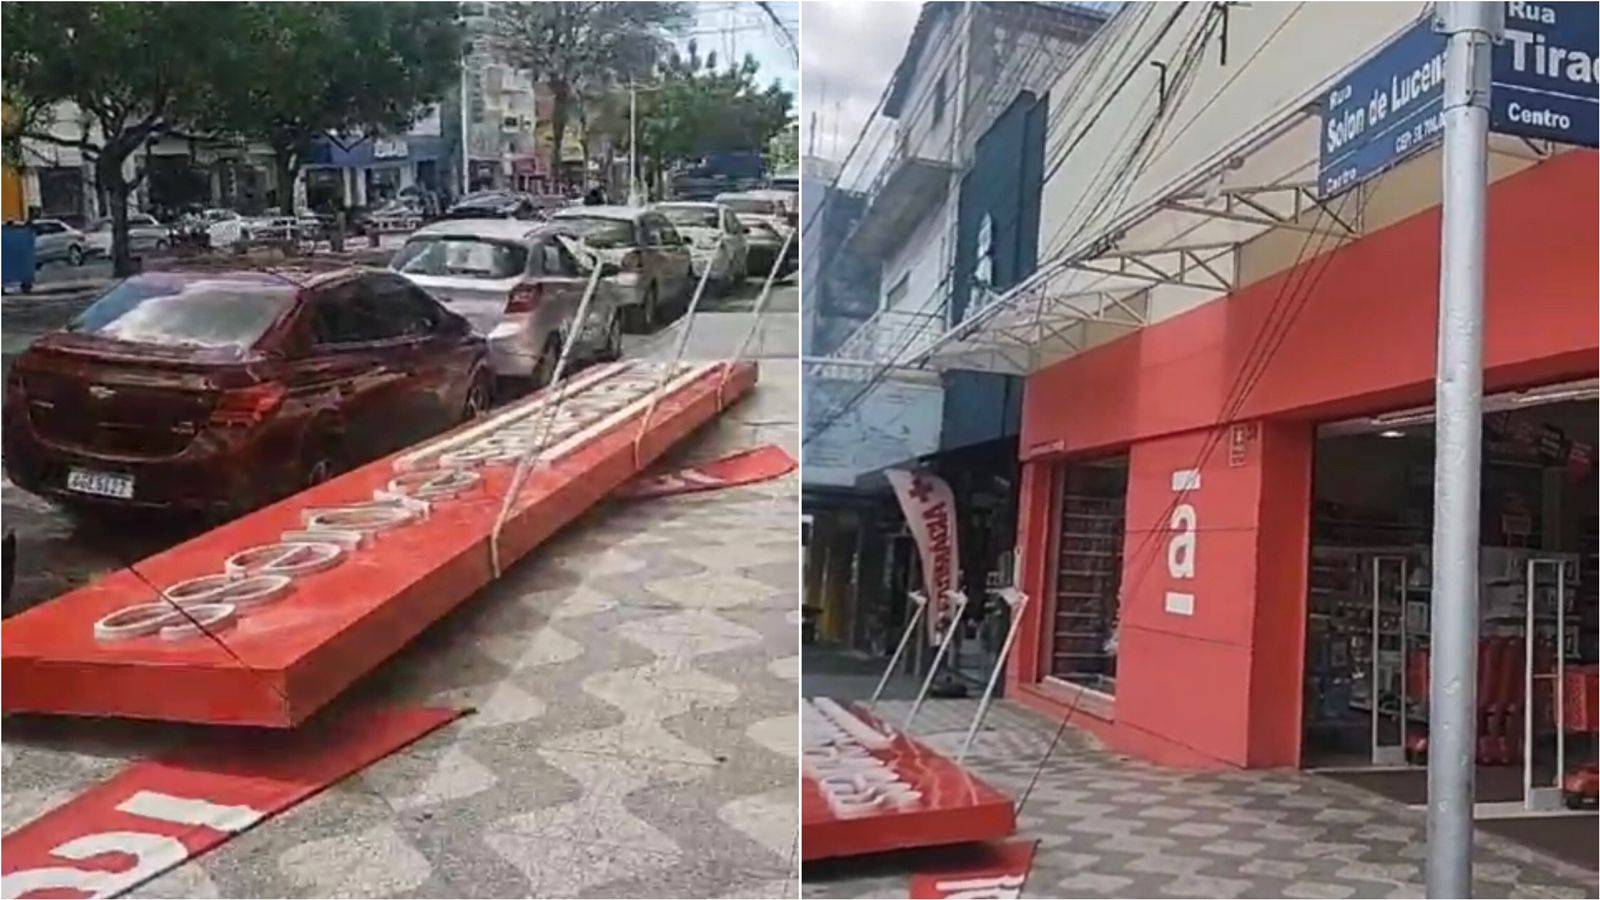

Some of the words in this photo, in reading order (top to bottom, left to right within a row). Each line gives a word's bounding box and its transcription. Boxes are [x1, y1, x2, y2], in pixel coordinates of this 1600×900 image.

[1508, 1, 1556, 24] Rua
[1327, 108, 1365, 152] Solon
[1369, 89, 1388, 126] de
[1391, 51, 1448, 112] Lucen
[1329, 85, 1353, 110] Rua
[1508, 102, 1570, 129] Centro
